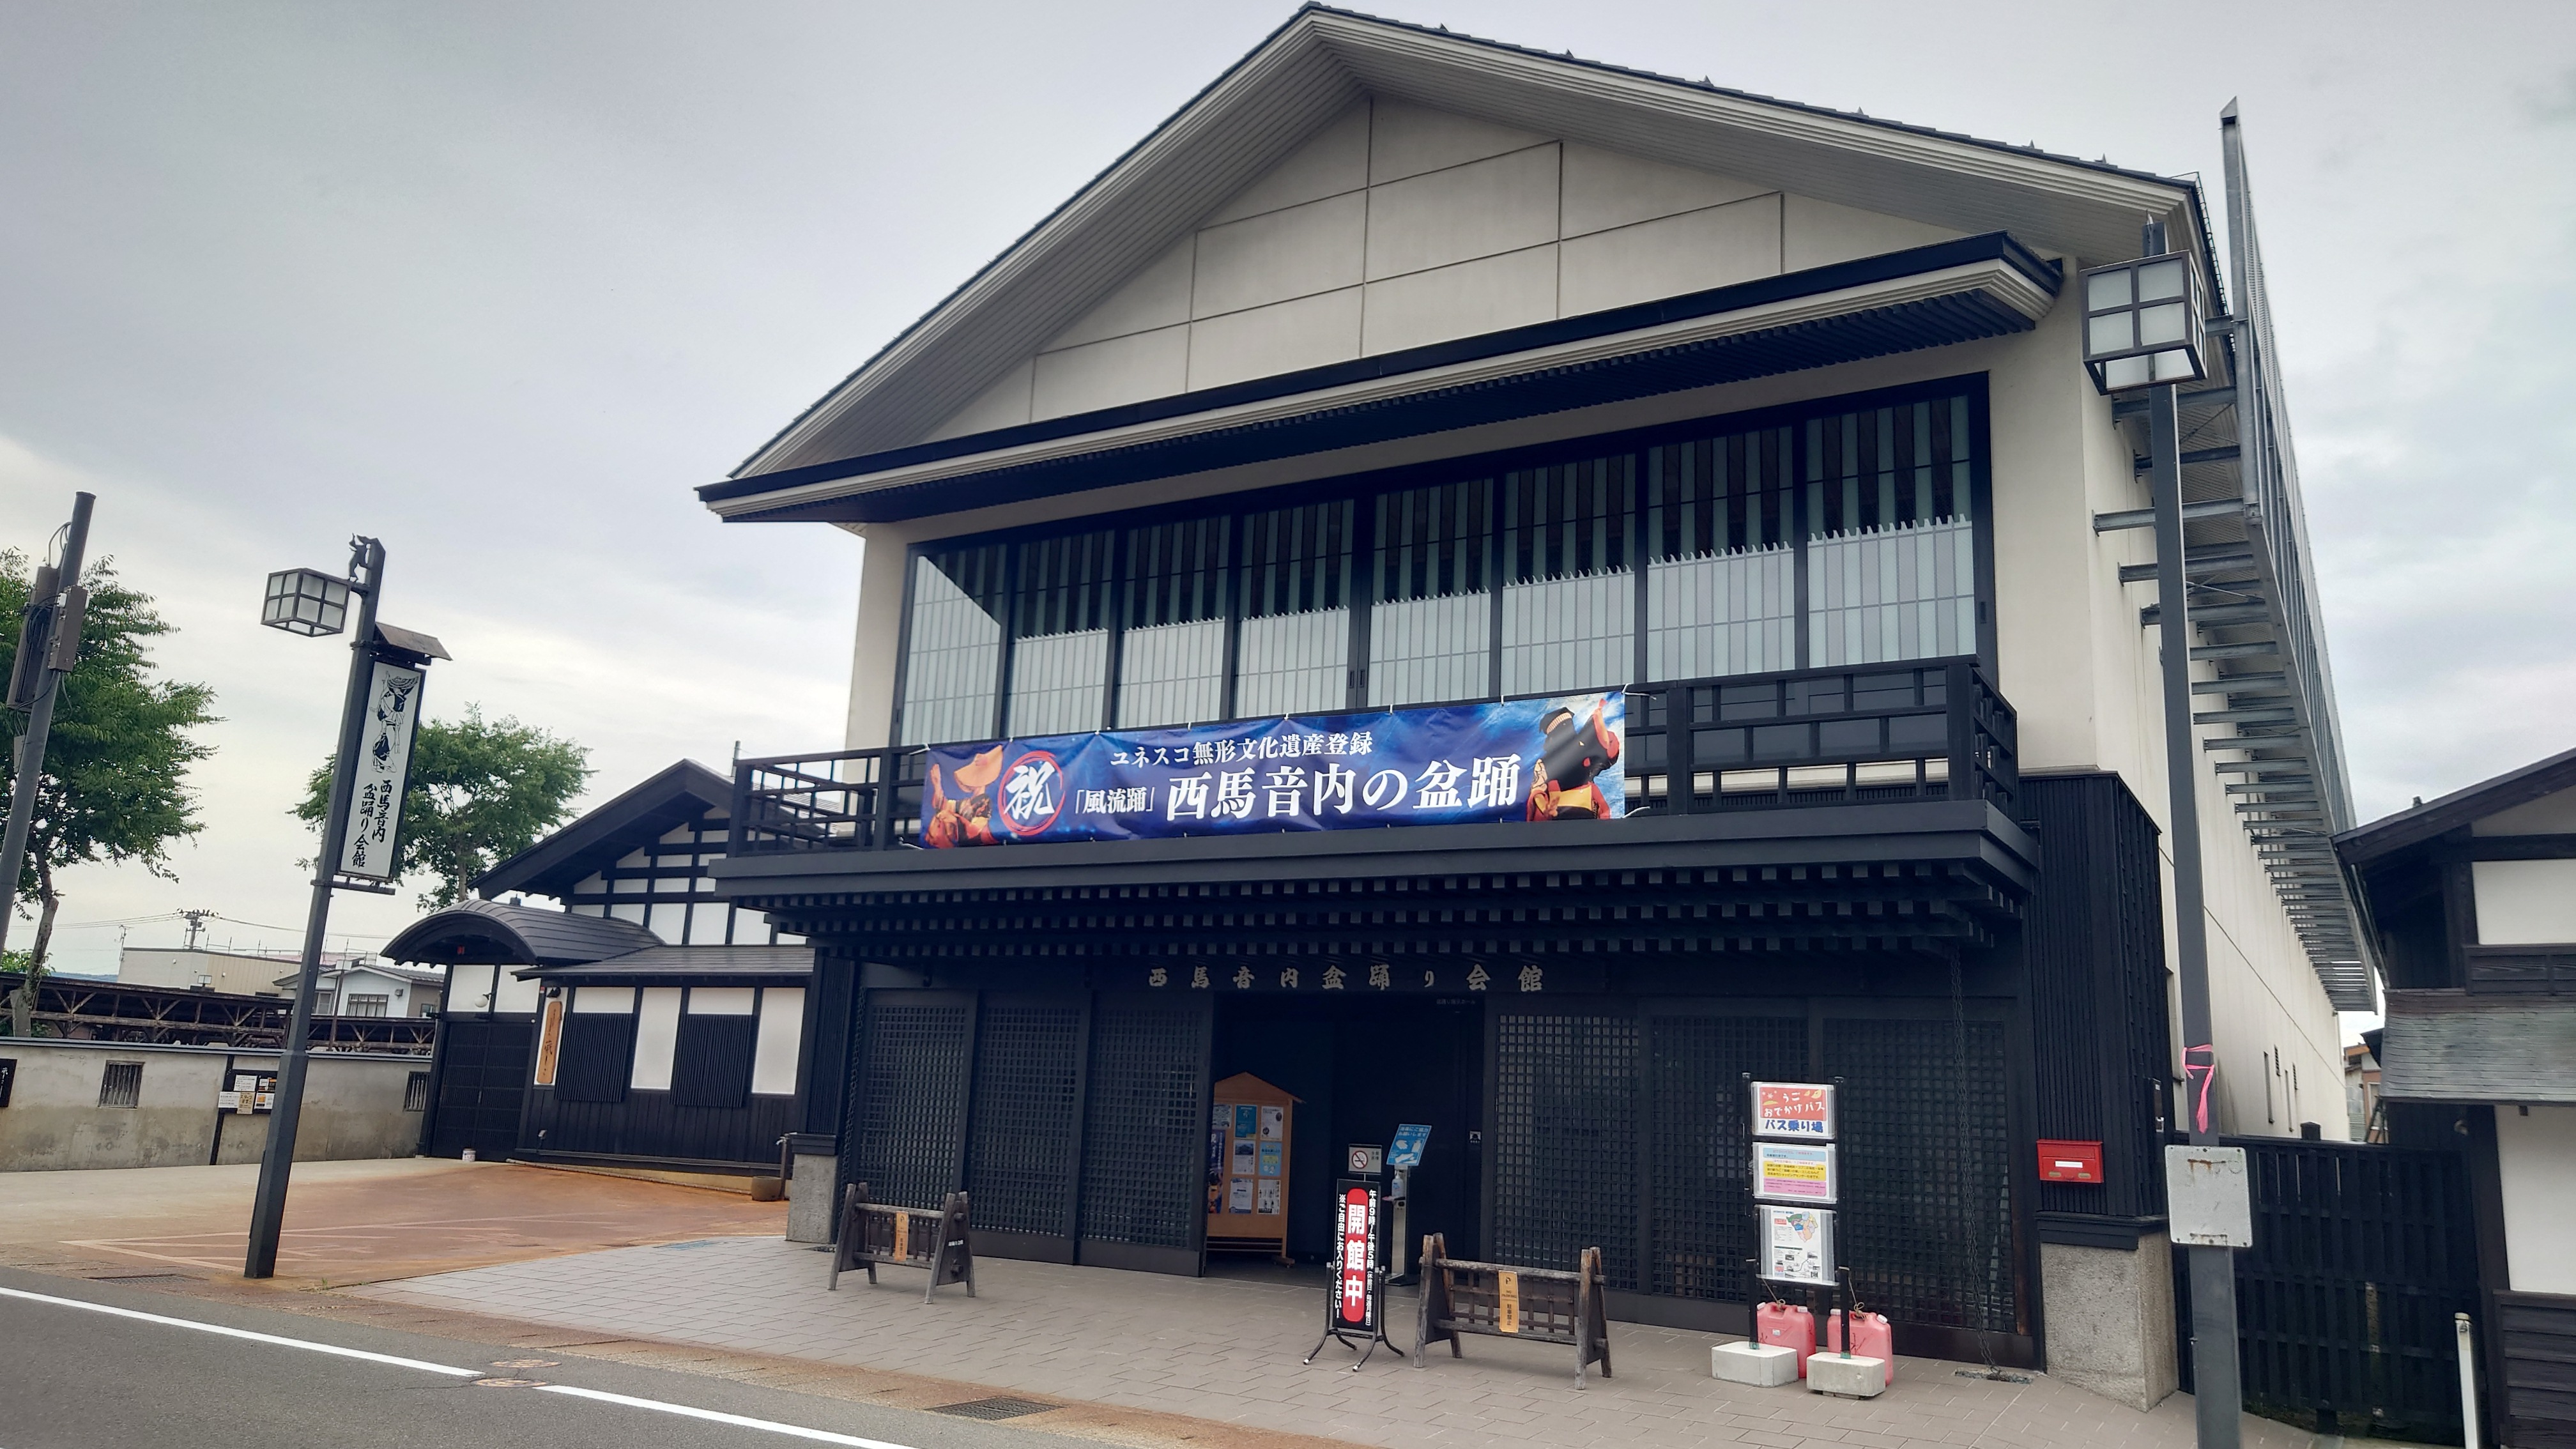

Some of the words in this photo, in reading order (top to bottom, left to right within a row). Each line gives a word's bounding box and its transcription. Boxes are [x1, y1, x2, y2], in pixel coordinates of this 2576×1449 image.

[1110, 731, 1372, 768] ユネスコ無形文化遺産登録
[371, 779, 392, 843] 西馬音内
[1004, 762, 1055, 820] 祝
[1075, 786, 1155, 814] 「風流踊」
[1167, 753, 1521, 822] 西馬音内の盆踊
[351, 783, 376, 868] 盆踊り会館
[1148, 963, 1544, 992] 西馬音内盆踊り会館
[1764, 1101, 1826, 1118] おでかけバス
[1782, 1092, 1800, 1103] うご
[1765, 1119, 1824, 1133] バス乗り場
[1346, 1204, 1365, 1306] 開館中
